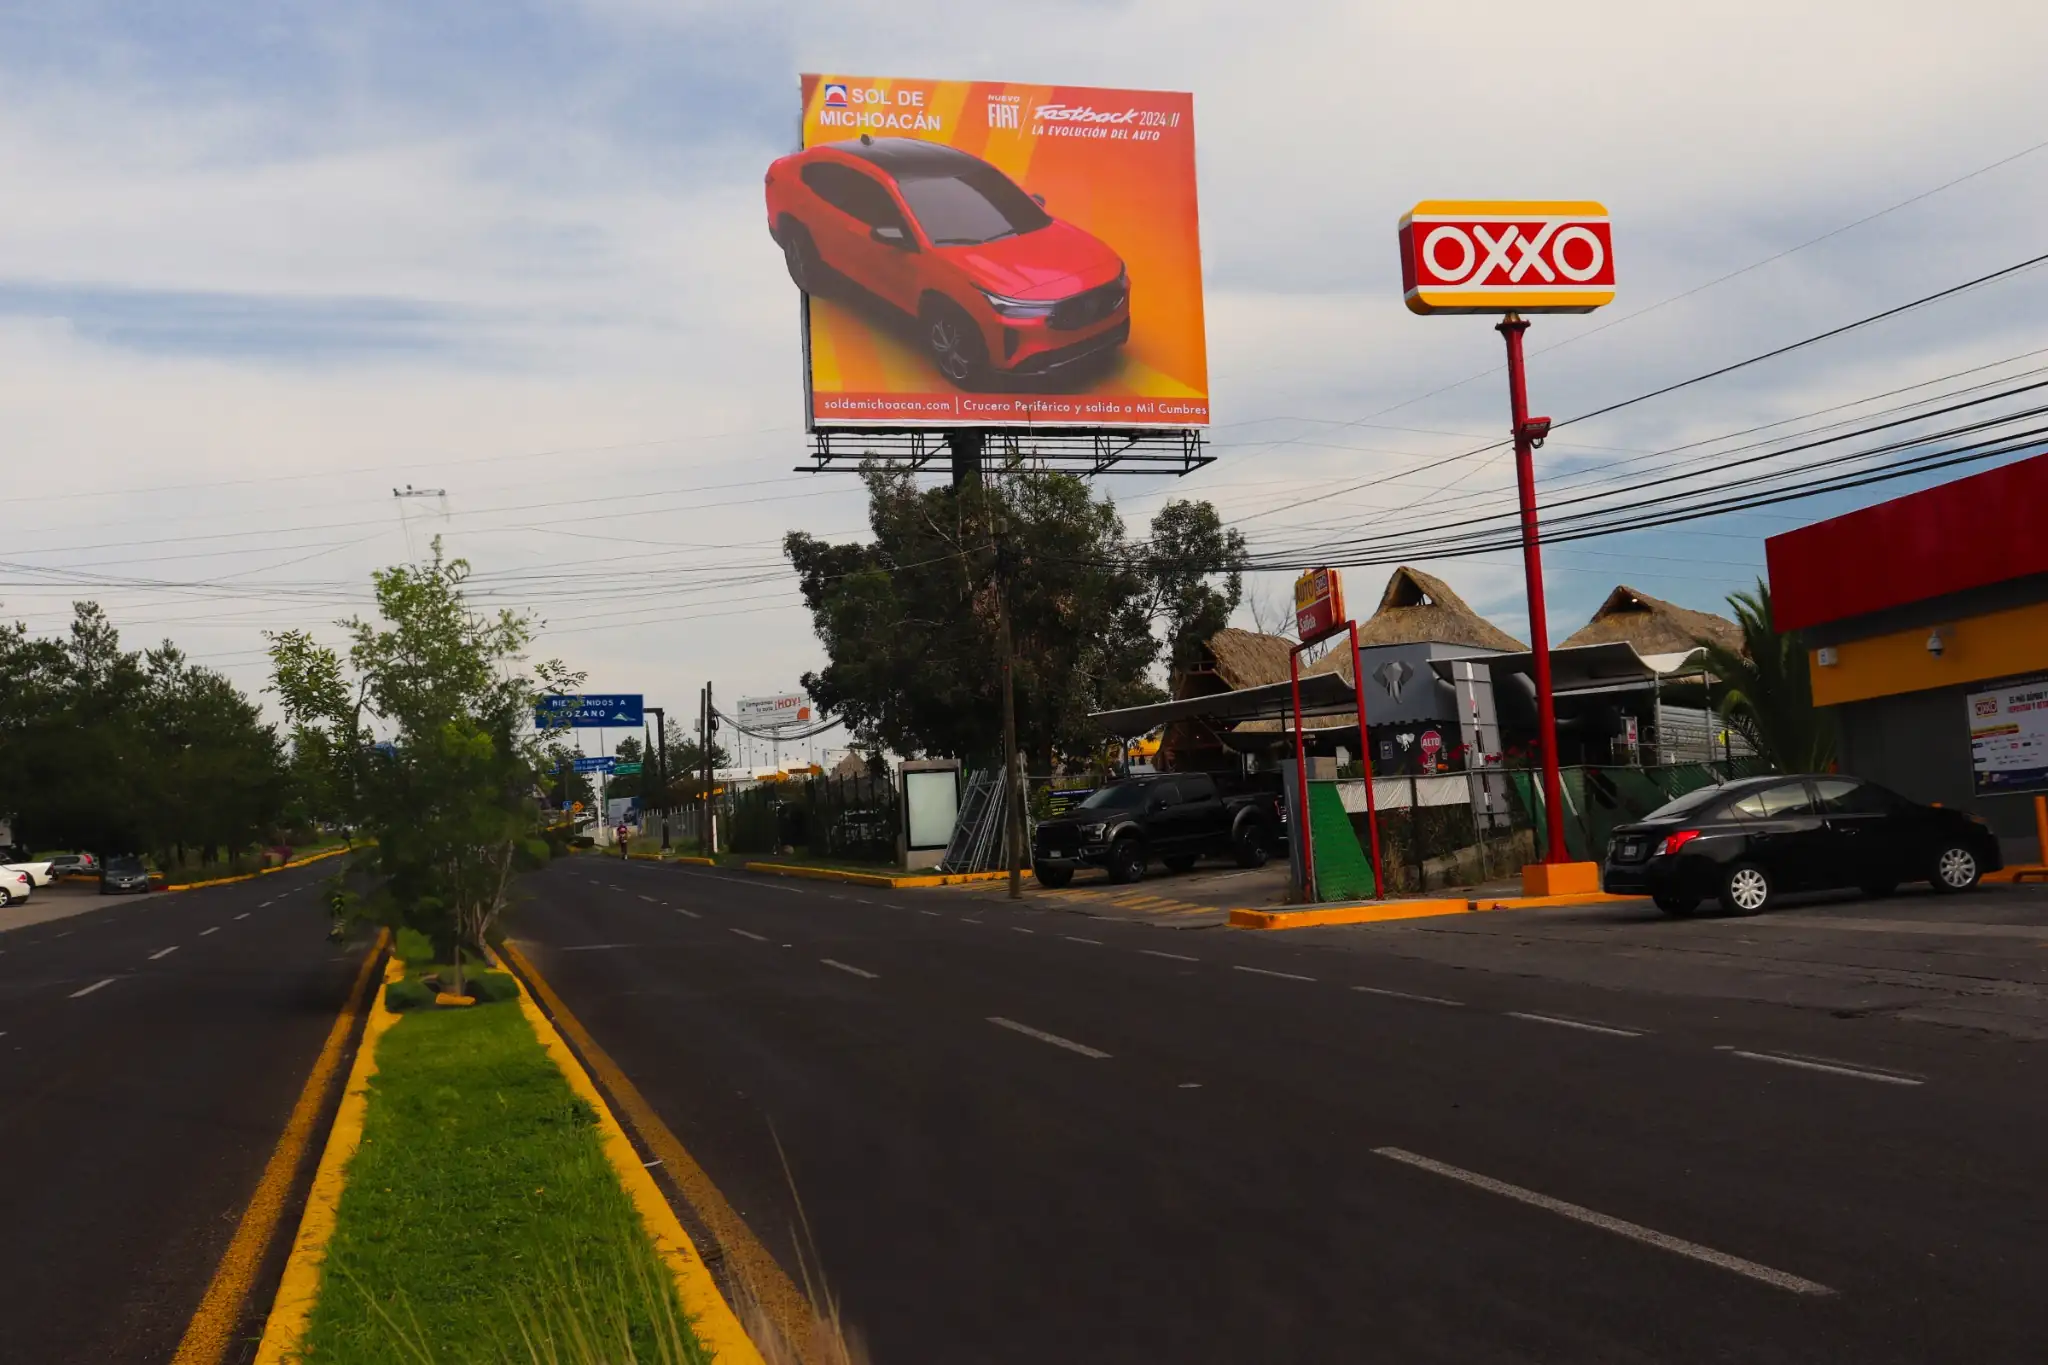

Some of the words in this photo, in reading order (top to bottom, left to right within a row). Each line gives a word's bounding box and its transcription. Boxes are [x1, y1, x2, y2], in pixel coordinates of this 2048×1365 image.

[851, 88, 892, 105] SOL
[897, 90, 924, 107] DE
[987, 95, 1021, 103] NUEVO
[819, 110, 941, 131] MICHOACÁN
[987, 104, 1020, 129] FIAT
[1033, 104, 1139, 125] Fastback
[1138, 111, 1166, 127] 2024
[1031, 125, 1044, 136] LA
[1047, 126, 1108, 139] EVOLUCIÓN
[1110, 130, 1129, 140] DEL
[1131, 131, 1161, 141] AUTO
[1422, 224, 1605, 283] OXXO
[824, 398, 950, 411] soldemichoacan.com
[963, 399, 1011, 412] Crucero
[1014, 400, 1071, 413] Periférico
[1075, 404, 1082, 415] y
[1085, 402, 1121, 414] salida
[1124, 405, 1133, 414] a
[1136, 403, 1155, 414] Mil
[1158, 403, 1208, 416] Cumbres
[1422, 738, 1440, 747] ALTO
